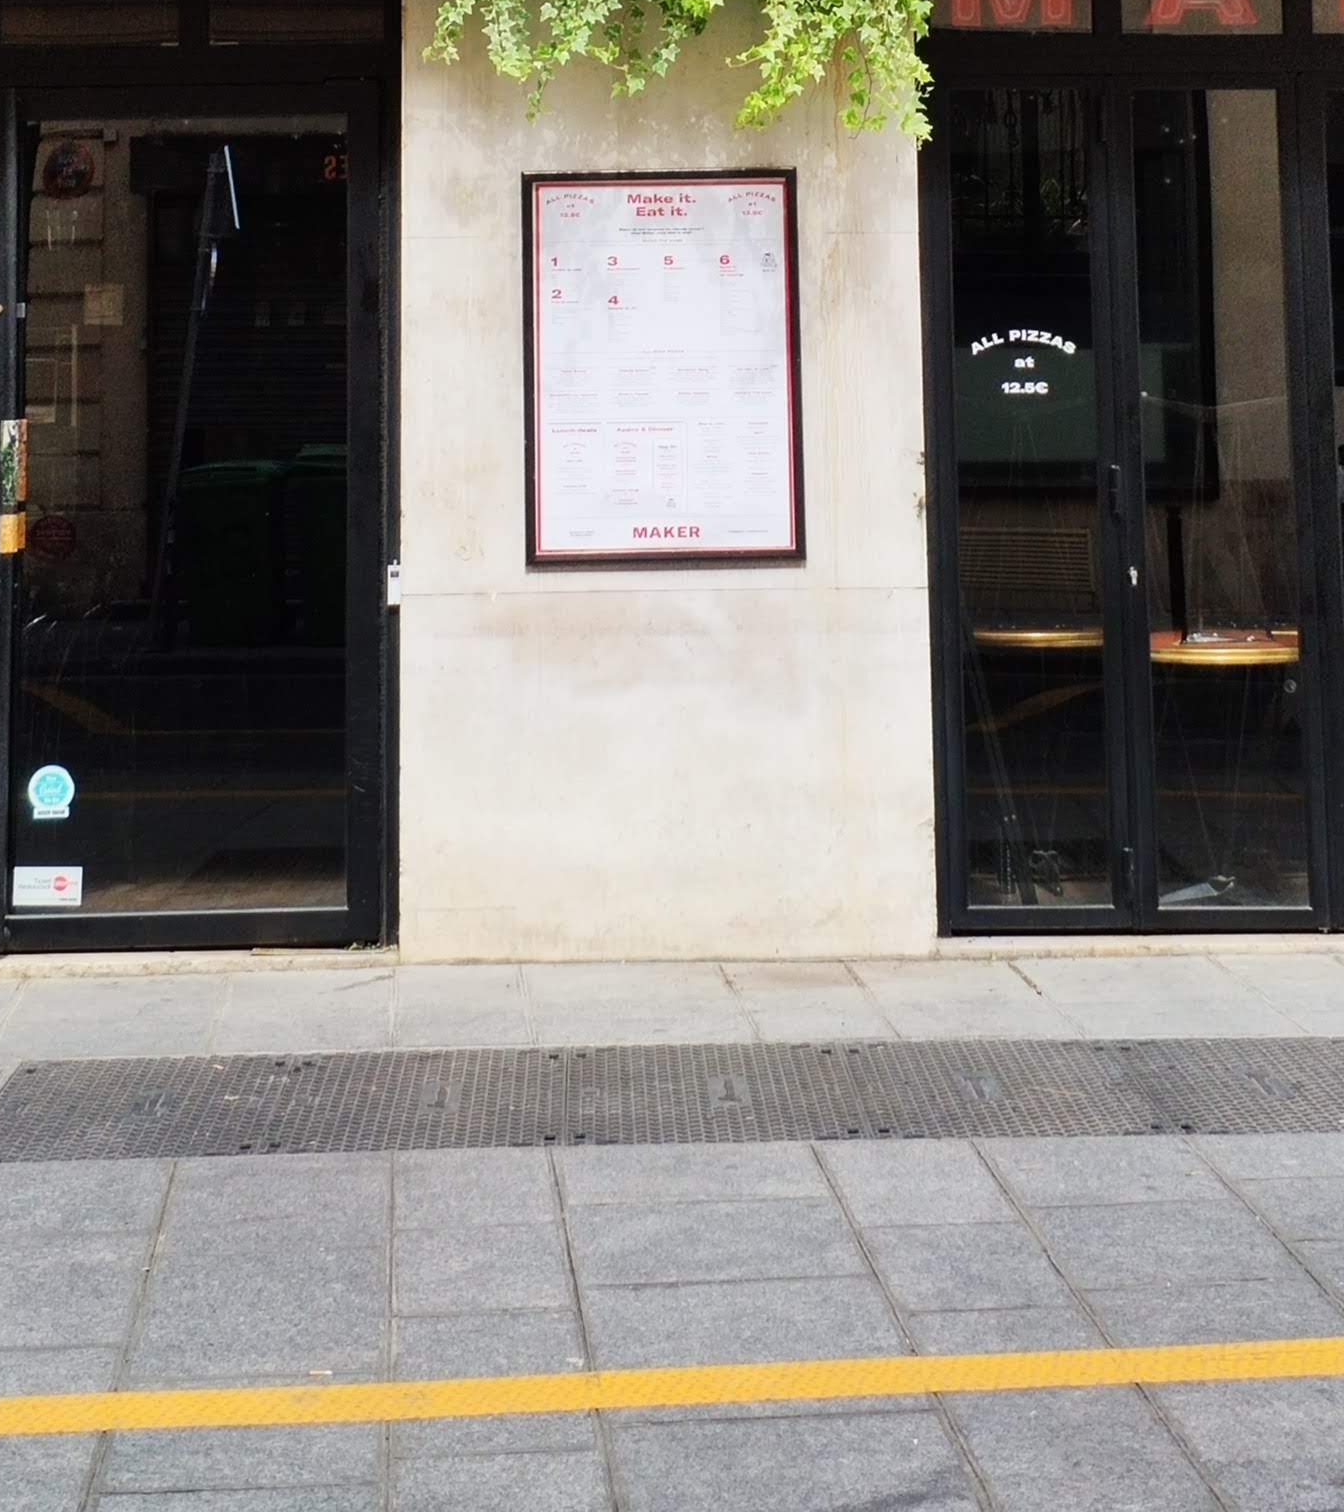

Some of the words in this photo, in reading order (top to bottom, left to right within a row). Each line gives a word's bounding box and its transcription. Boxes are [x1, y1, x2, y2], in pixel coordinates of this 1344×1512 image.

[626, 193, 674, 205] Make
[679, 192, 697, 204] it.
[635, 206, 667, 218] Eat
[669, 205, 688, 217] it.
[551, 257, 558, 267] 1
[607, 256, 618, 266] 3
[663, 255, 674, 266] 5
[719, 254, 730, 265] 6
[551, 289, 562, 299] 2
[608, 295, 620, 305] 4
[971, 333, 1005, 356] ALL
[1008, 329, 1077, 355] PIZZAS
[1014, 355, 1035, 369] at
[1000, 381, 1049, 394] 12.5€
[632, 525, 701, 539] MAKER
